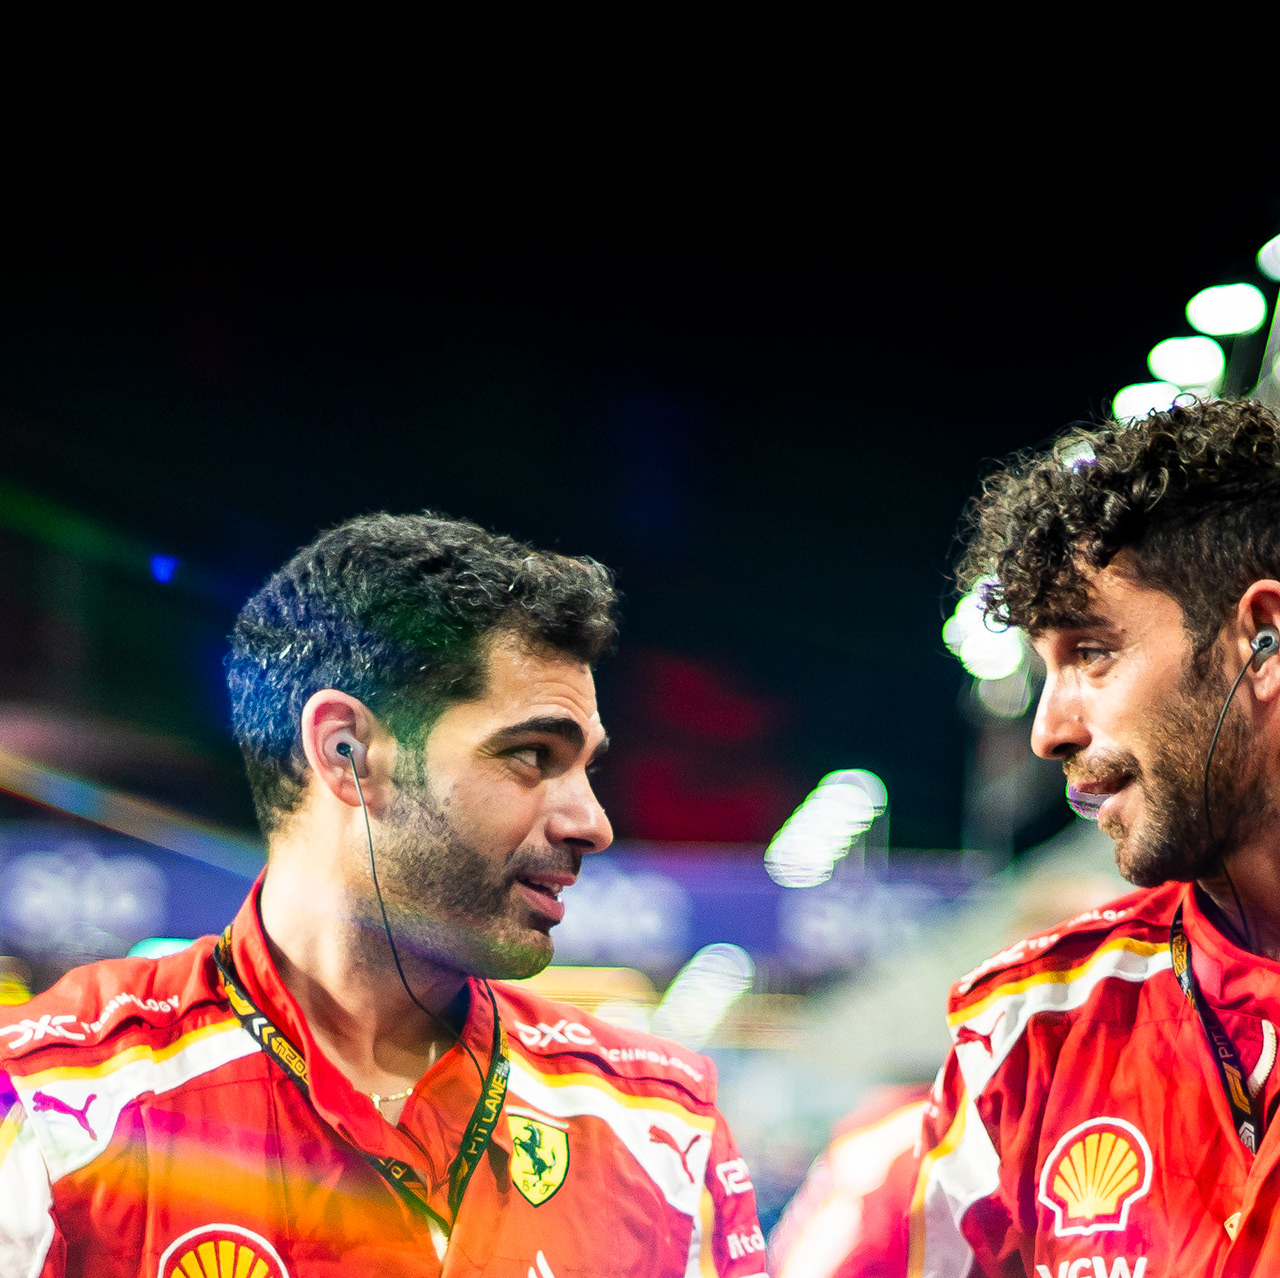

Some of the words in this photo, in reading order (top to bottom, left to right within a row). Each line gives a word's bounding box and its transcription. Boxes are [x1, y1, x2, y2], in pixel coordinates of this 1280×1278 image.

[514, 1019, 594, 1047] DXC
[598, 1046, 705, 1083] CHNOLO
[481, 1073, 508, 1123] LANE
